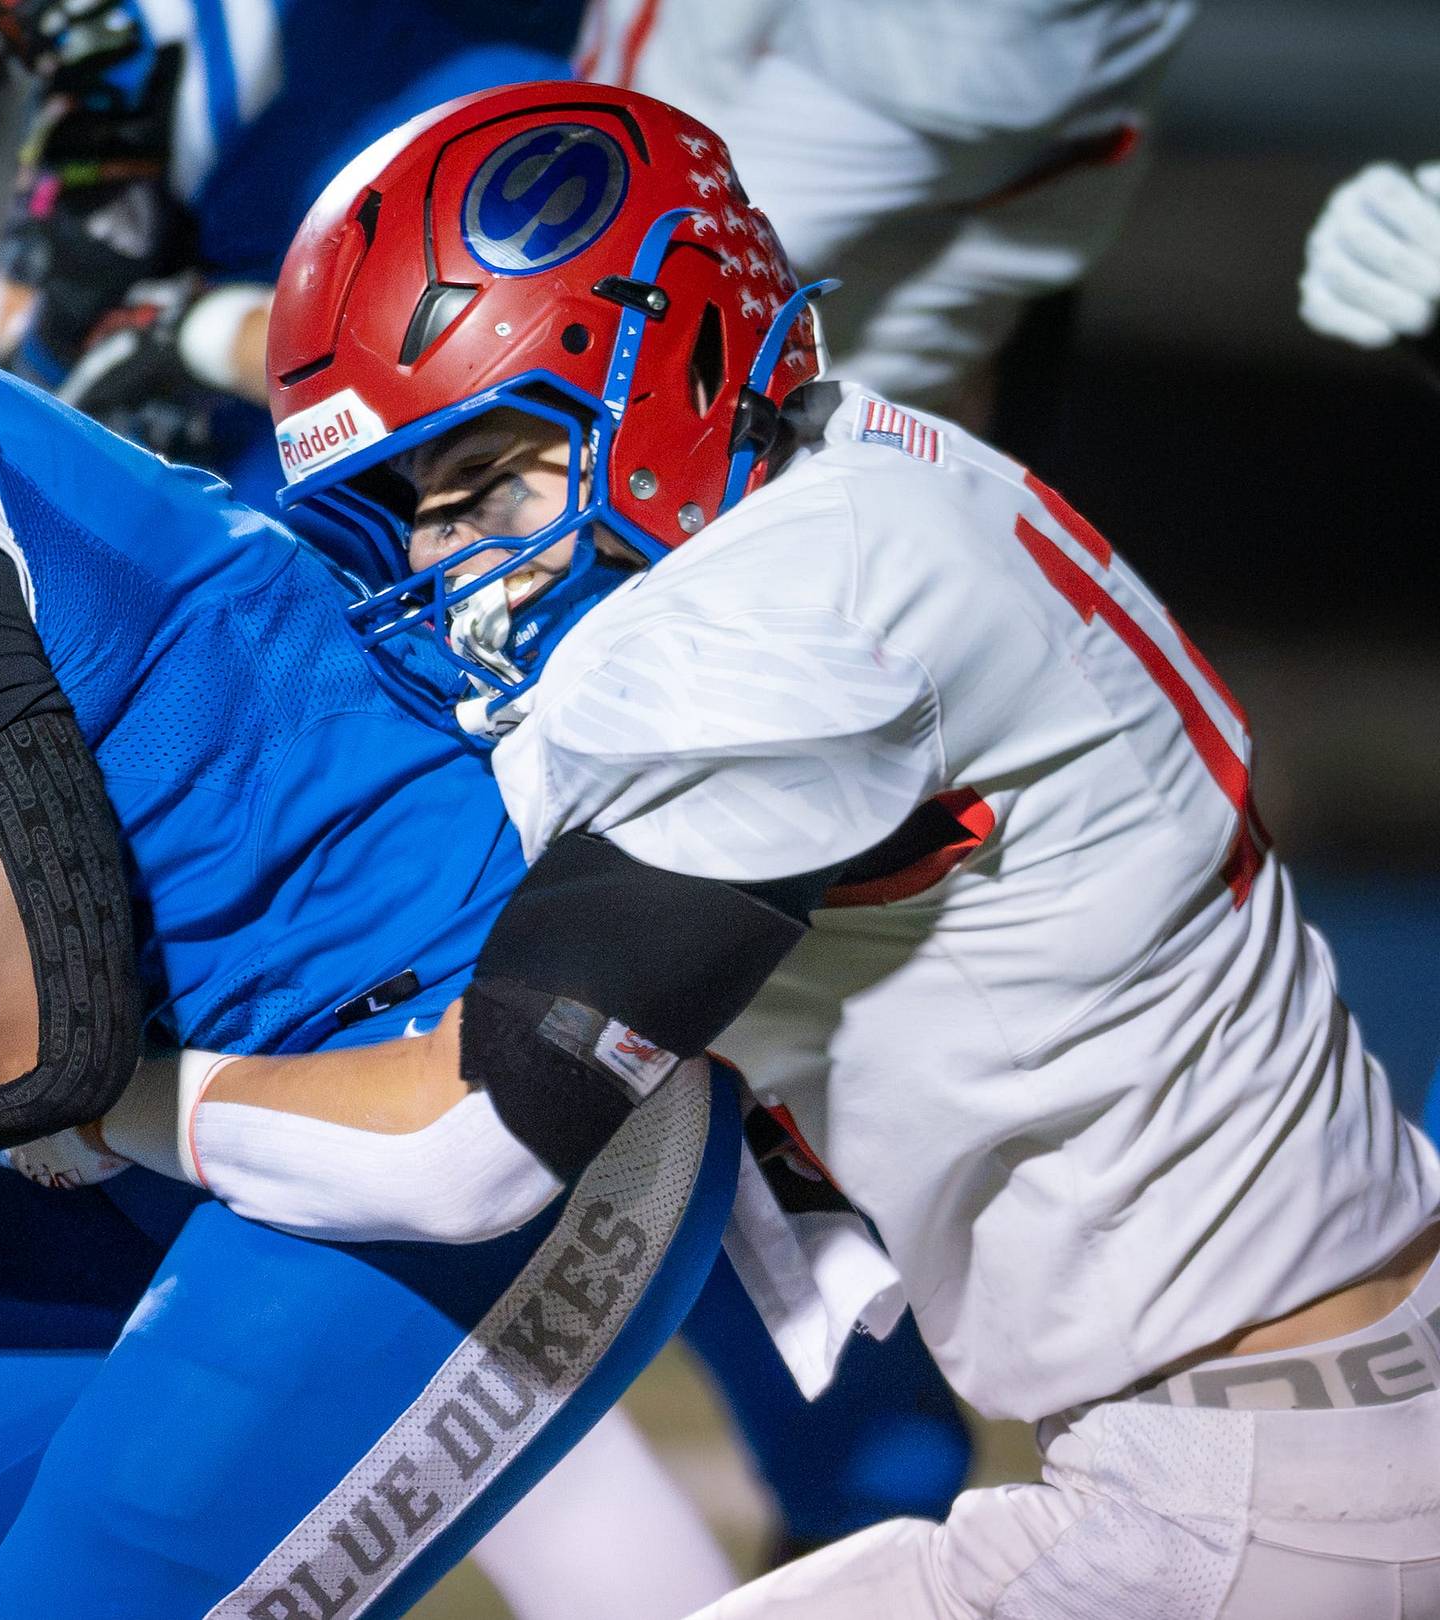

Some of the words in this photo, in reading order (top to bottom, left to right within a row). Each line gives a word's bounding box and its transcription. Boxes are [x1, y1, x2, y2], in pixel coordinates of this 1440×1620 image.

[478, 130, 610, 262] S
[280, 408, 359, 469] Riddell
[425, 1201, 647, 1480] DUKES
